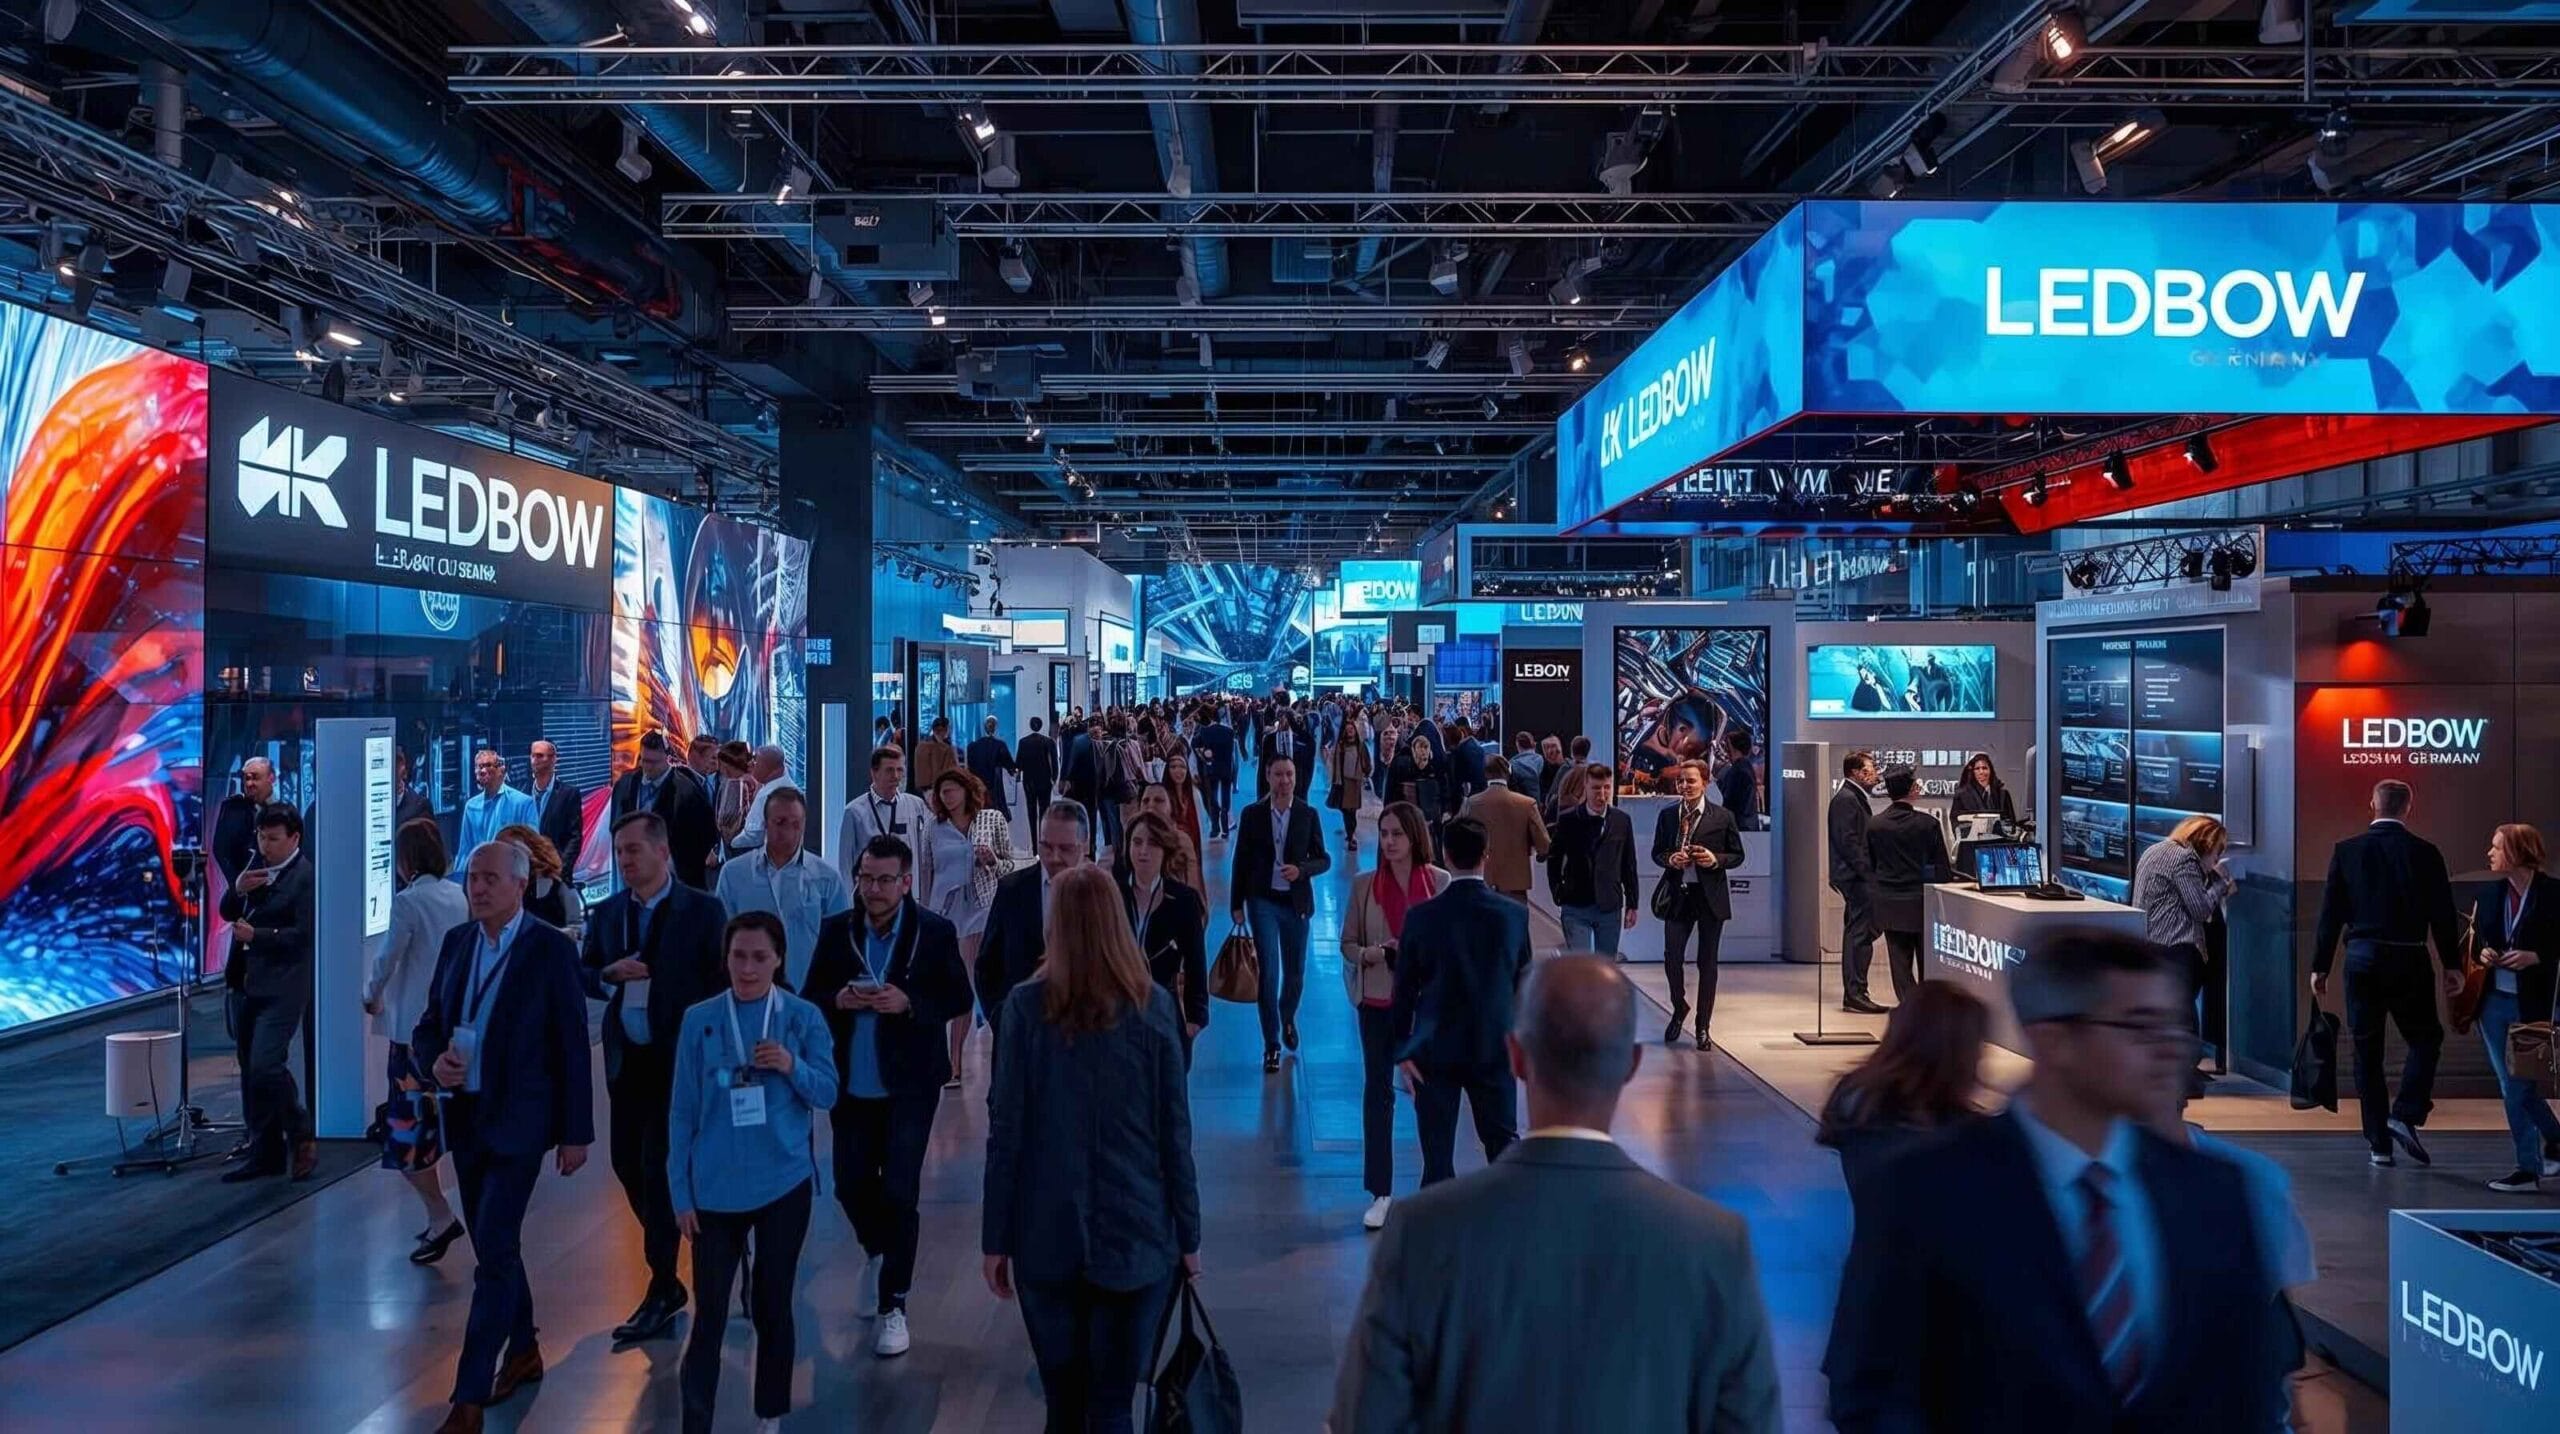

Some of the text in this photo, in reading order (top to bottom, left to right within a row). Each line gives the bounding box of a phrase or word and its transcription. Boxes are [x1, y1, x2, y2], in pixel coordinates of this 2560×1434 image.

[1986, 266, 2366, 338] LEDBOW
[1627, 336, 1716, 450] LEDBOW
[375, 446, 604, 568] LEDBOW
[2342, 718, 2484, 749] LEDBOW
[2402, 1280, 2544, 1391] LEDBOW
